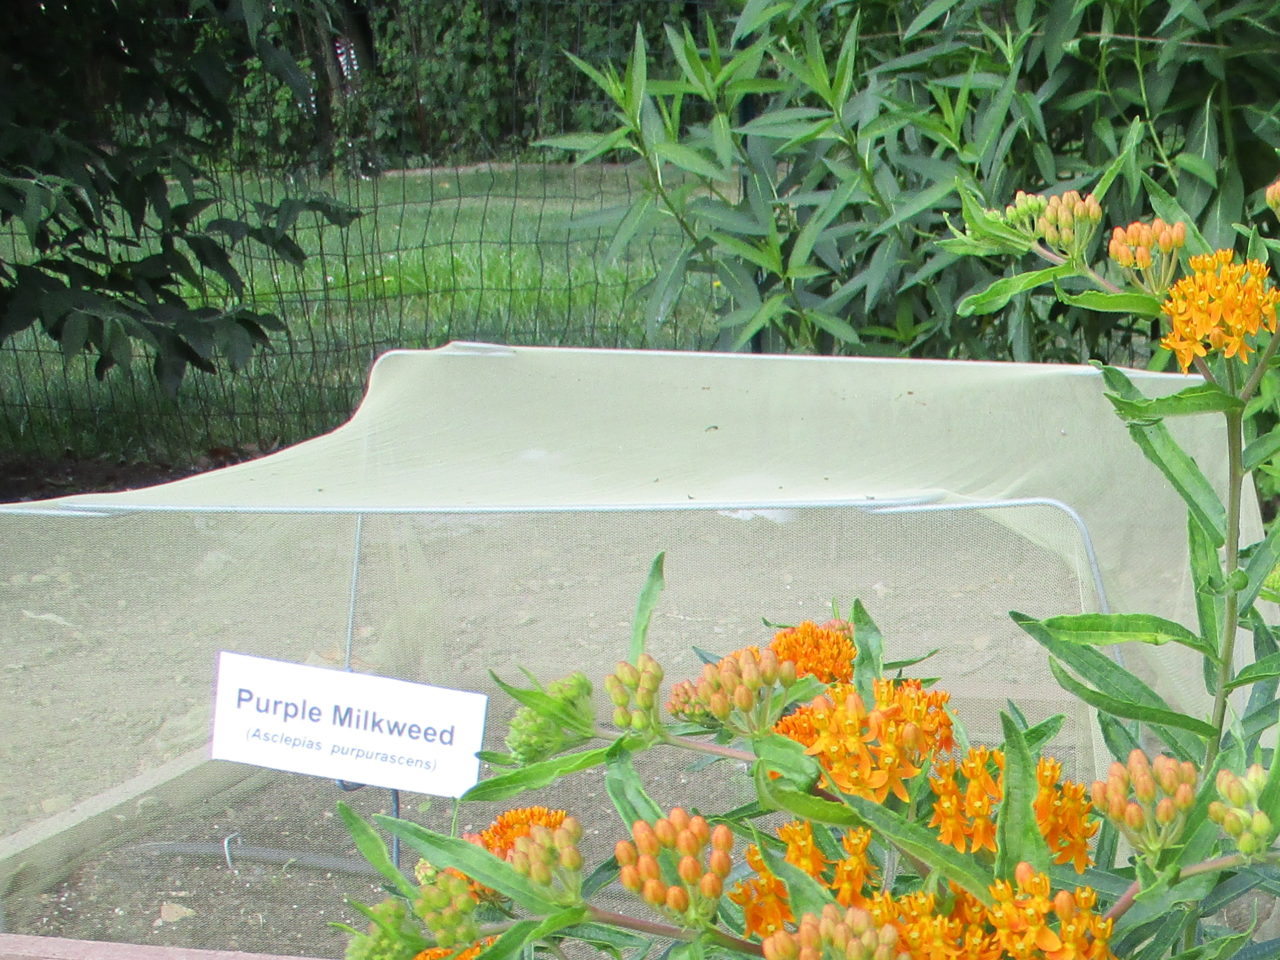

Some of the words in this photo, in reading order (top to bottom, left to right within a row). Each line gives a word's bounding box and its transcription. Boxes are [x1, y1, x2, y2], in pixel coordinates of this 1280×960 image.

[236, 687, 323, 723] Purple
[331, 704, 456, 746] Milkweed
[245, 727, 323, 751] (Asclepias
[329, 742, 438, 772] purpurascens)
